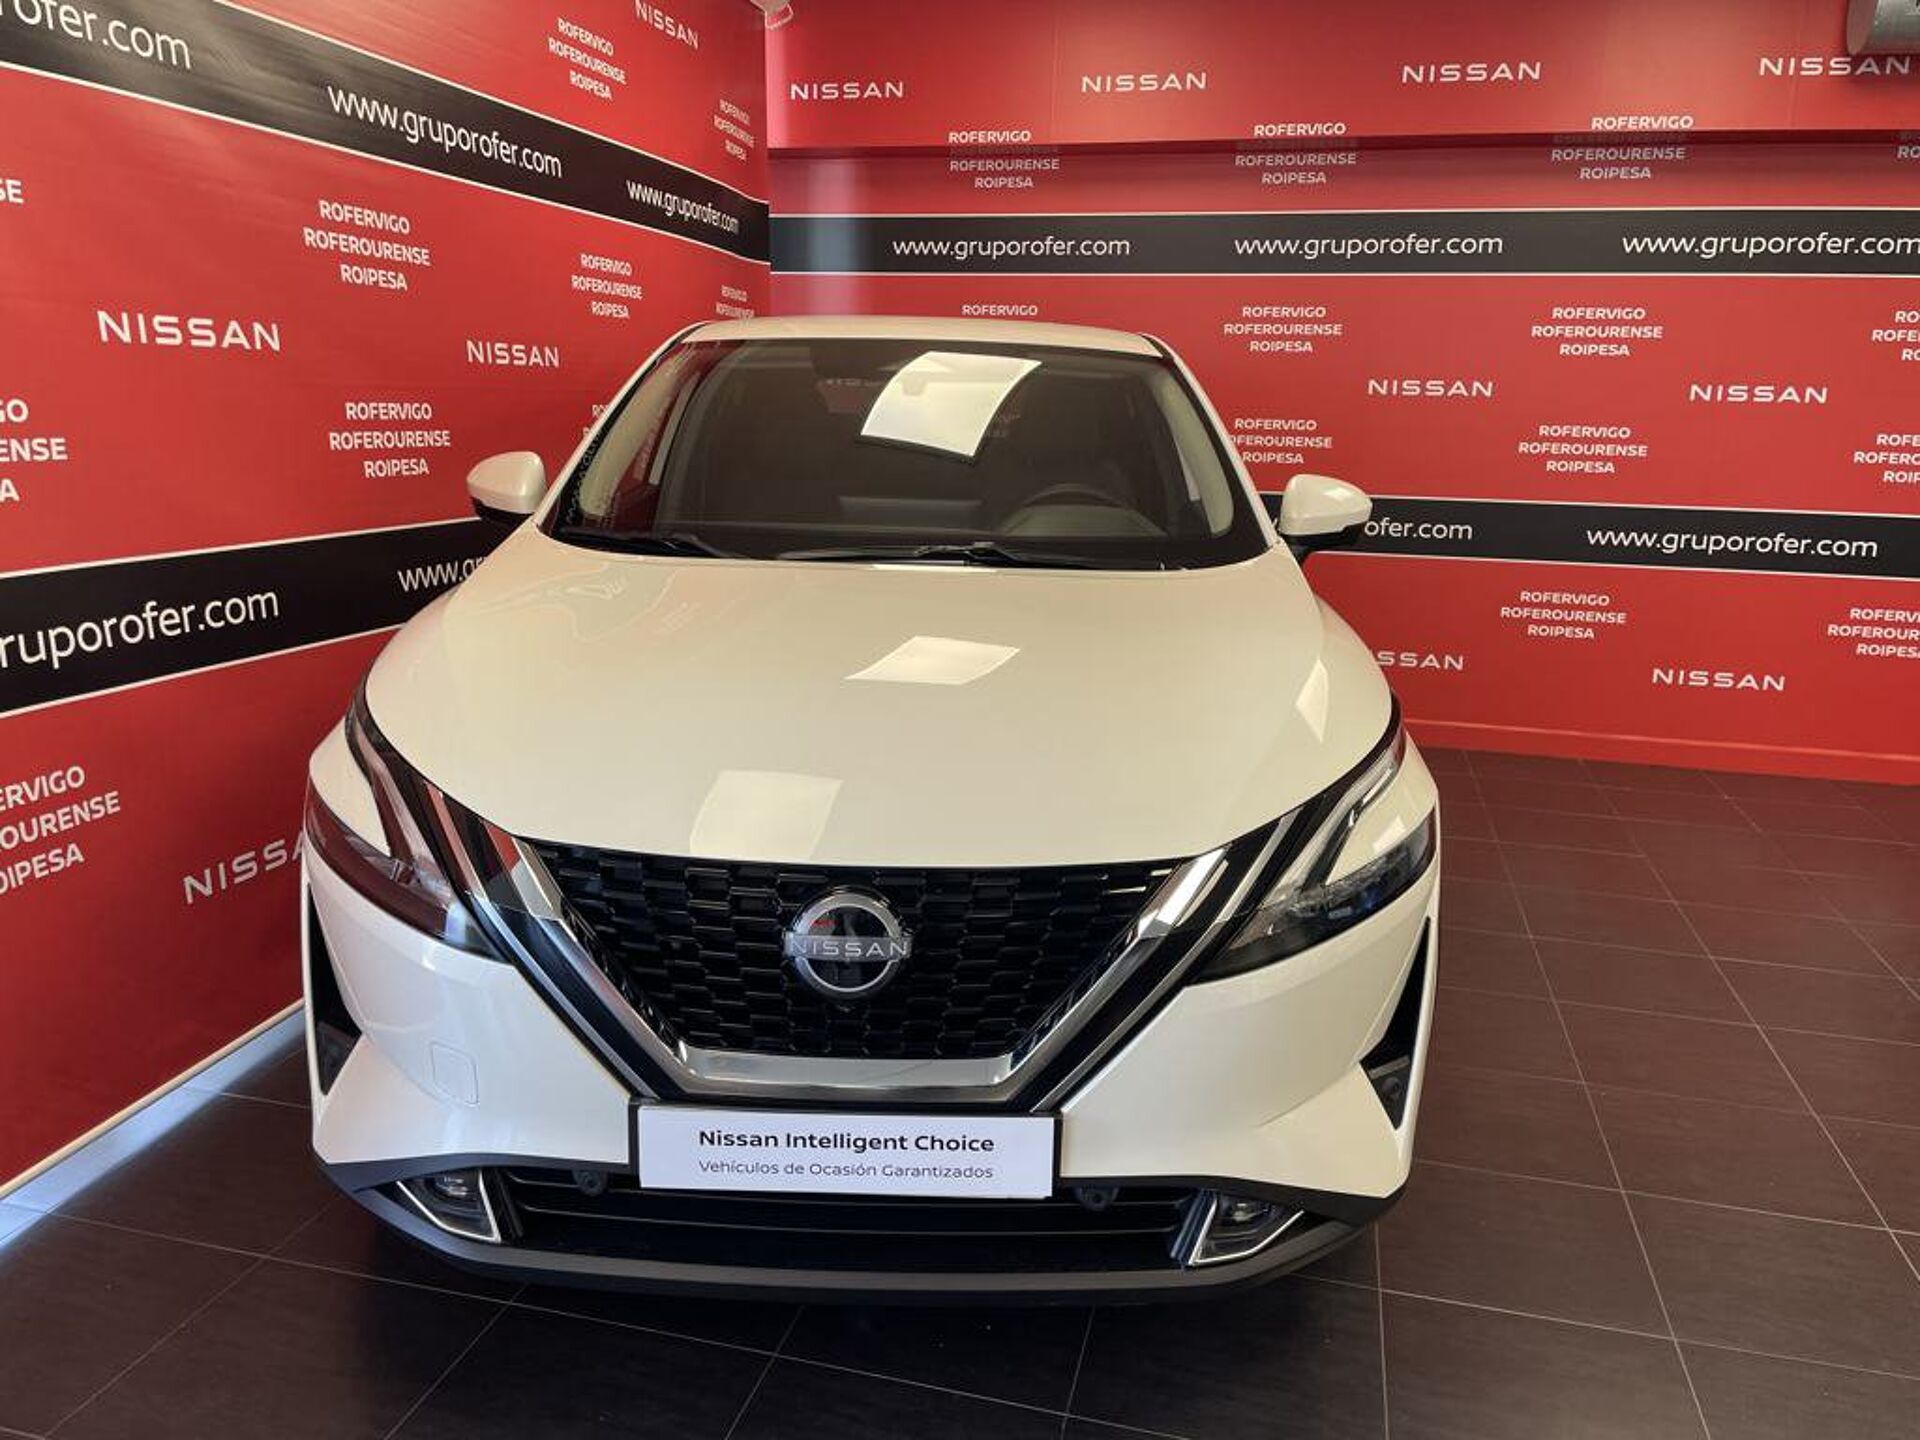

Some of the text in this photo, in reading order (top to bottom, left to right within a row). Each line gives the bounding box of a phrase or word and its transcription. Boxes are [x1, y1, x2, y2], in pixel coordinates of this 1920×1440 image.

[635, 0, 699, 50] NISSAN
[0, 0, 191, 69] ofer.com
[1402, 62, 1541, 84] NISSAN
[1759, 56, 1911, 76] NISSAN
[790, 82, 904, 100] NISSAN
[1081, 72, 1207, 93] NISSAN
[1253, 122, 1346, 137] ROFERVIGO
[1590, 115, 1694, 130] ROFERVIGO
[328, 85, 562, 179] www.gruporofer.com
[948, 130, 1032, 143] ROFERVIGO
[1235, 153, 1357, 166] ROFEROURENSE
[1551, 147, 1687, 161] ROFEROURENSE
[950, 159, 1060, 172] ROFEROURENSE
[1580, 167, 1651, 179] ROIPESA
[974, 177, 1034, 188] ROIPESA
[1261, 172, 1327, 184] ROIPESA
[626, 180, 739, 235] www.gruporofer.com
[319, 199, 410, 235] ROFERVIGO
[303, 227, 431, 266] ROFEROURENSE
[893, 236, 1131, 260] www.gruporofer.com
[1234, 233, 1503, 259] www.gruporofer.com
[1622, 232, 1920, 259] www.gruporofer.com
[340, 263, 408, 291] ROIPESA
[961, 304, 1039, 317] ROFERVIGO
[1242, 306, 1326, 318] ROFERVIGO
[1552, 306, 1646, 320] ROFERVIGO
[97, 310, 281, 352] NISSAN
[1224, 324, 1344, 336] ROFEROURENSE
[1532, 325, 1664, 339] ROFEROURENSE
[1872, 329, 1920, 342] ROFE
[466, 341, 560, 368] NISSAN
[1250, 341, 1314, 353] ROIPESA
[1559, 343, 1630, 357] ROIPESA
[1367, 379, 1494, 398] NISSAN
[1689, 384, 1828, 404] NISSAN
[345, 402, 432, 420] ROFERVIGO
[1234, 418, 1318, 431] ROFERVIGO
[1539, 424, 1631, 439] ROFERVIGO
[329, 431, 450, 450] ROFEROURENSE
[1243, 451, 1304, 464] ROIPESA
[1518, 442, 1648, 457] ROFEROURENSE
[364, 459, 429, 478] ROIPESA
[1546, 460, 1615, 473] ROIPESA
[1587, 529, 1878, 558] www.gruporofer.com
[1520, 591, 1610, 606] ROFERVIGO
[1500, 606, 1627, 624] ROFEROURENSE
[1850, 608, 1920, 623] ROFERV
[1527, 624, 1595, 639] ROIPESA
[1856, 643, 1920, 658] ROIPES
[1653, 668, 1785, 691] NISSAN
[790, 940, 907, 957] NISSAN
[699, 1130, 995, 1154] Nissan Intelligent Choice
[699, 1159, 994, 1179] Vehículos de Ocasión Garantizados
